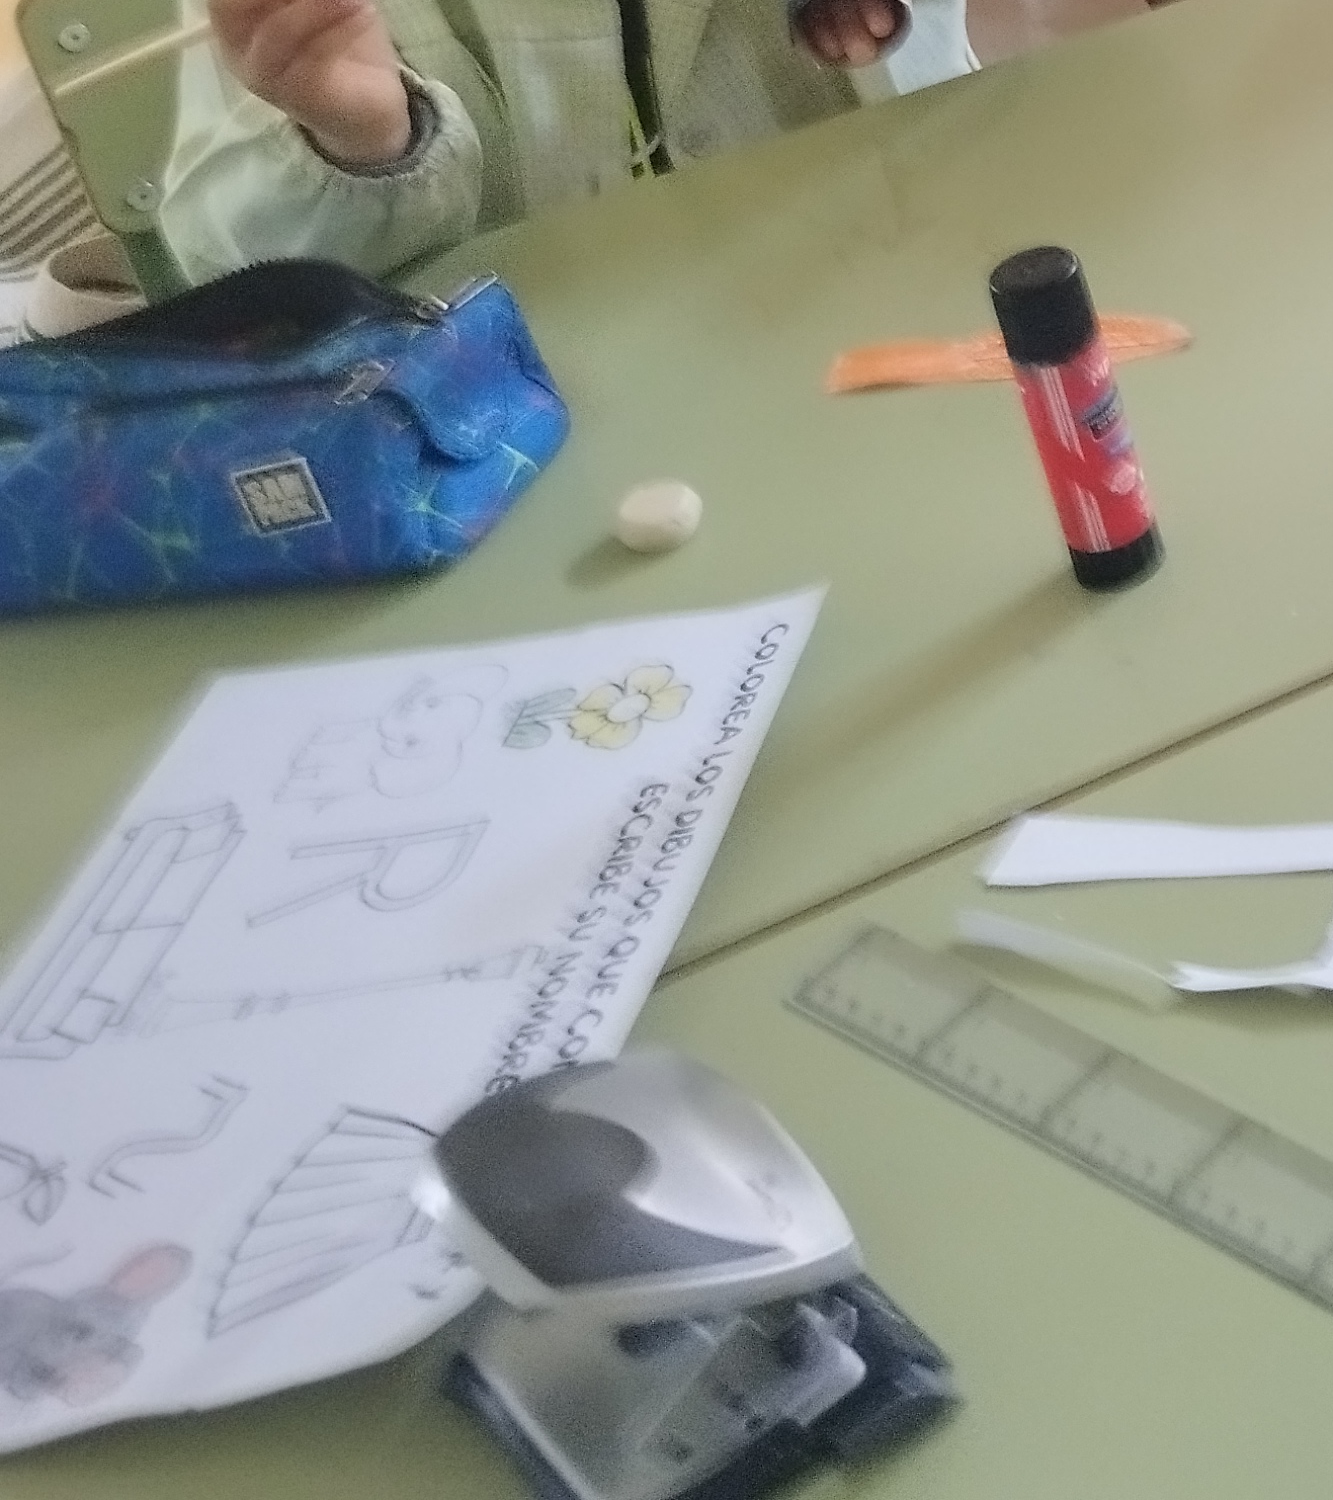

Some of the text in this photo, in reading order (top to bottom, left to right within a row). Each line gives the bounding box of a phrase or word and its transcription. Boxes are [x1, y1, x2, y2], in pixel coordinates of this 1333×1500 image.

[714, 622, 790, 746] COLOREA
[686, 750, 732, 803] LOS
[589, 782, 669, 901] ESCRIBE
[624, 808, 704, 927] DIBUJOS
[567, 906, 607, 942] SU
[585, 935, 640, 1001] QUE
